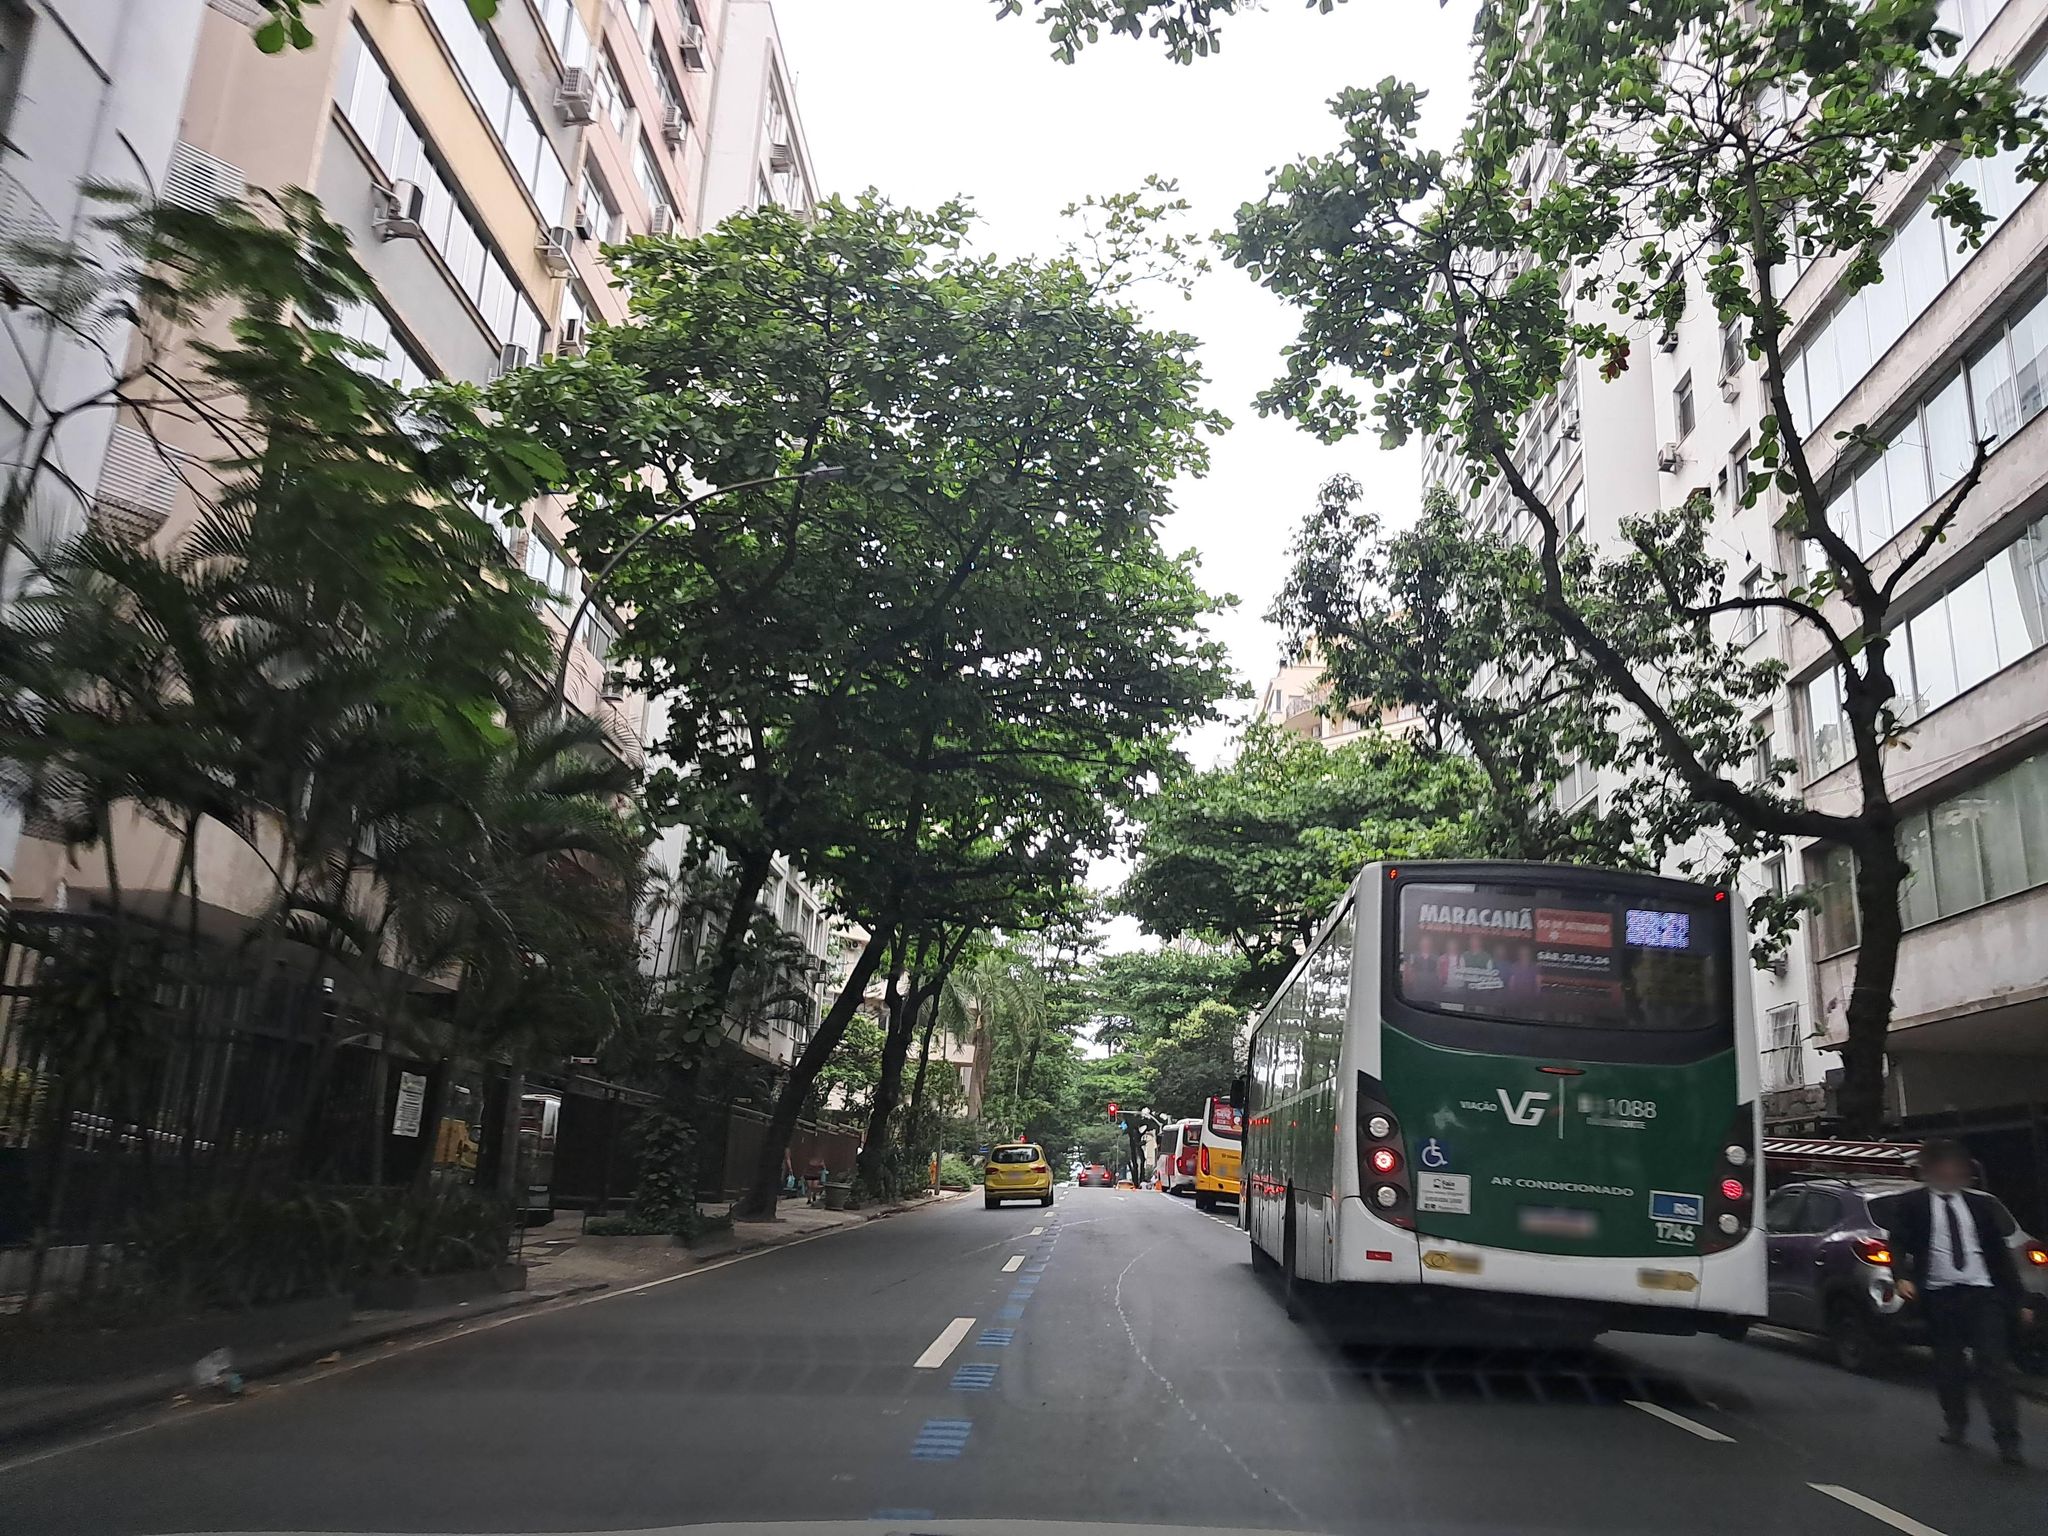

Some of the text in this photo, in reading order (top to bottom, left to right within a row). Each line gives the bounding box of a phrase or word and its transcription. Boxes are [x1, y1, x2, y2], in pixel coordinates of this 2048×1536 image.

[1419, 904, 1533, 930] MARACANÃ
[1491, 1176, 1634, 1197] AR CONDICIONADO
